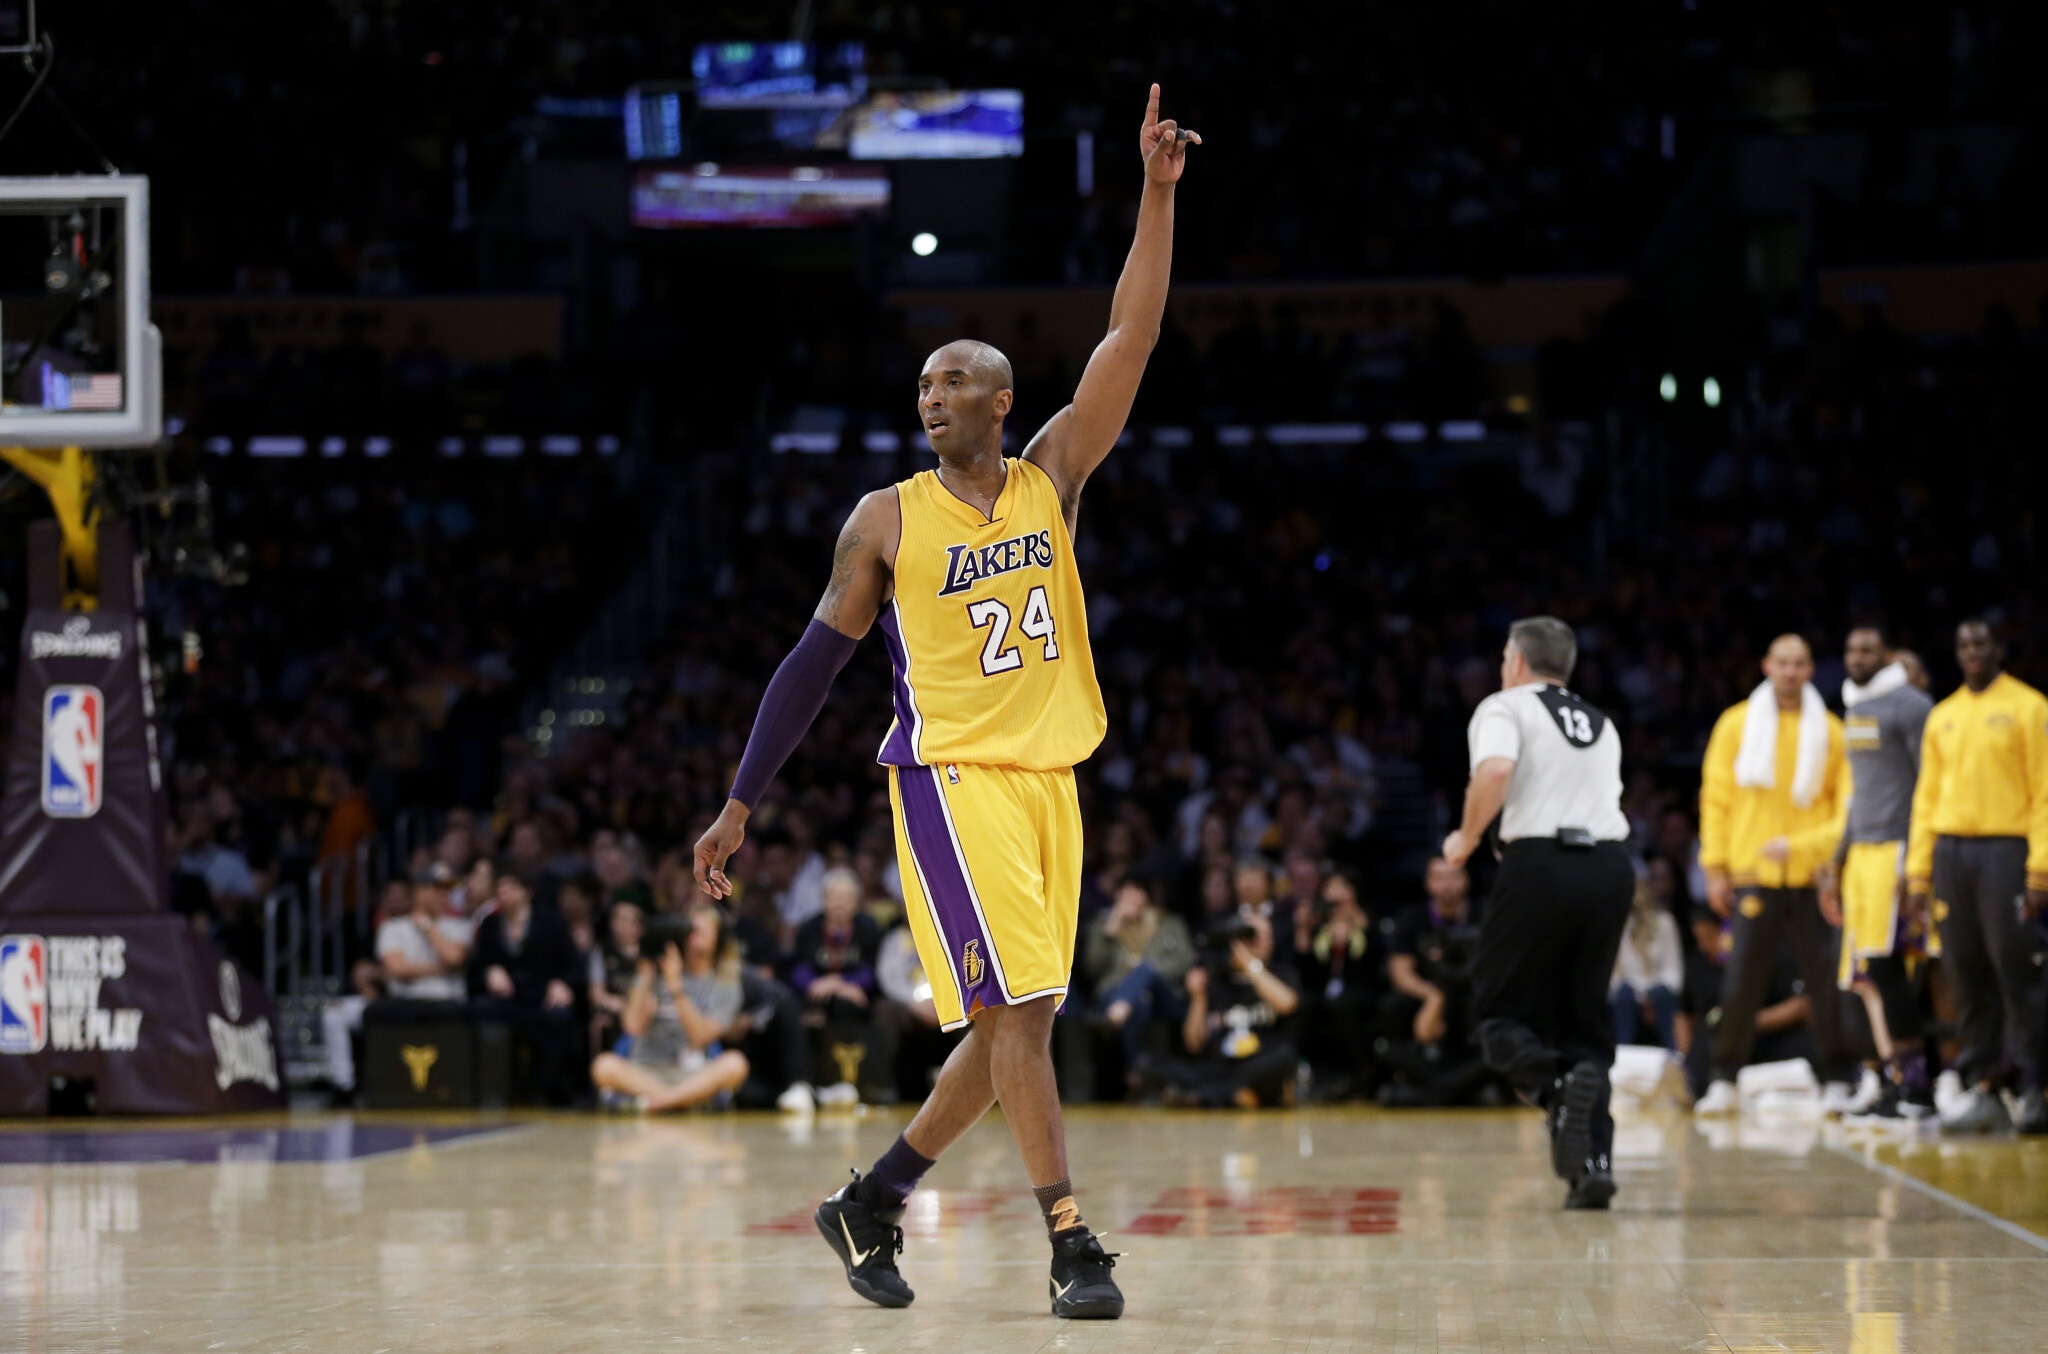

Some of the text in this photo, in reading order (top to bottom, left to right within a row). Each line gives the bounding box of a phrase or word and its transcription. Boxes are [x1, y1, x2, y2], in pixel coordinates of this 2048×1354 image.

[937, 529, 1053, 598] LAKERS
[966, 585, 1059, 677] 24
[1557, 706, 1593, 743] 13
